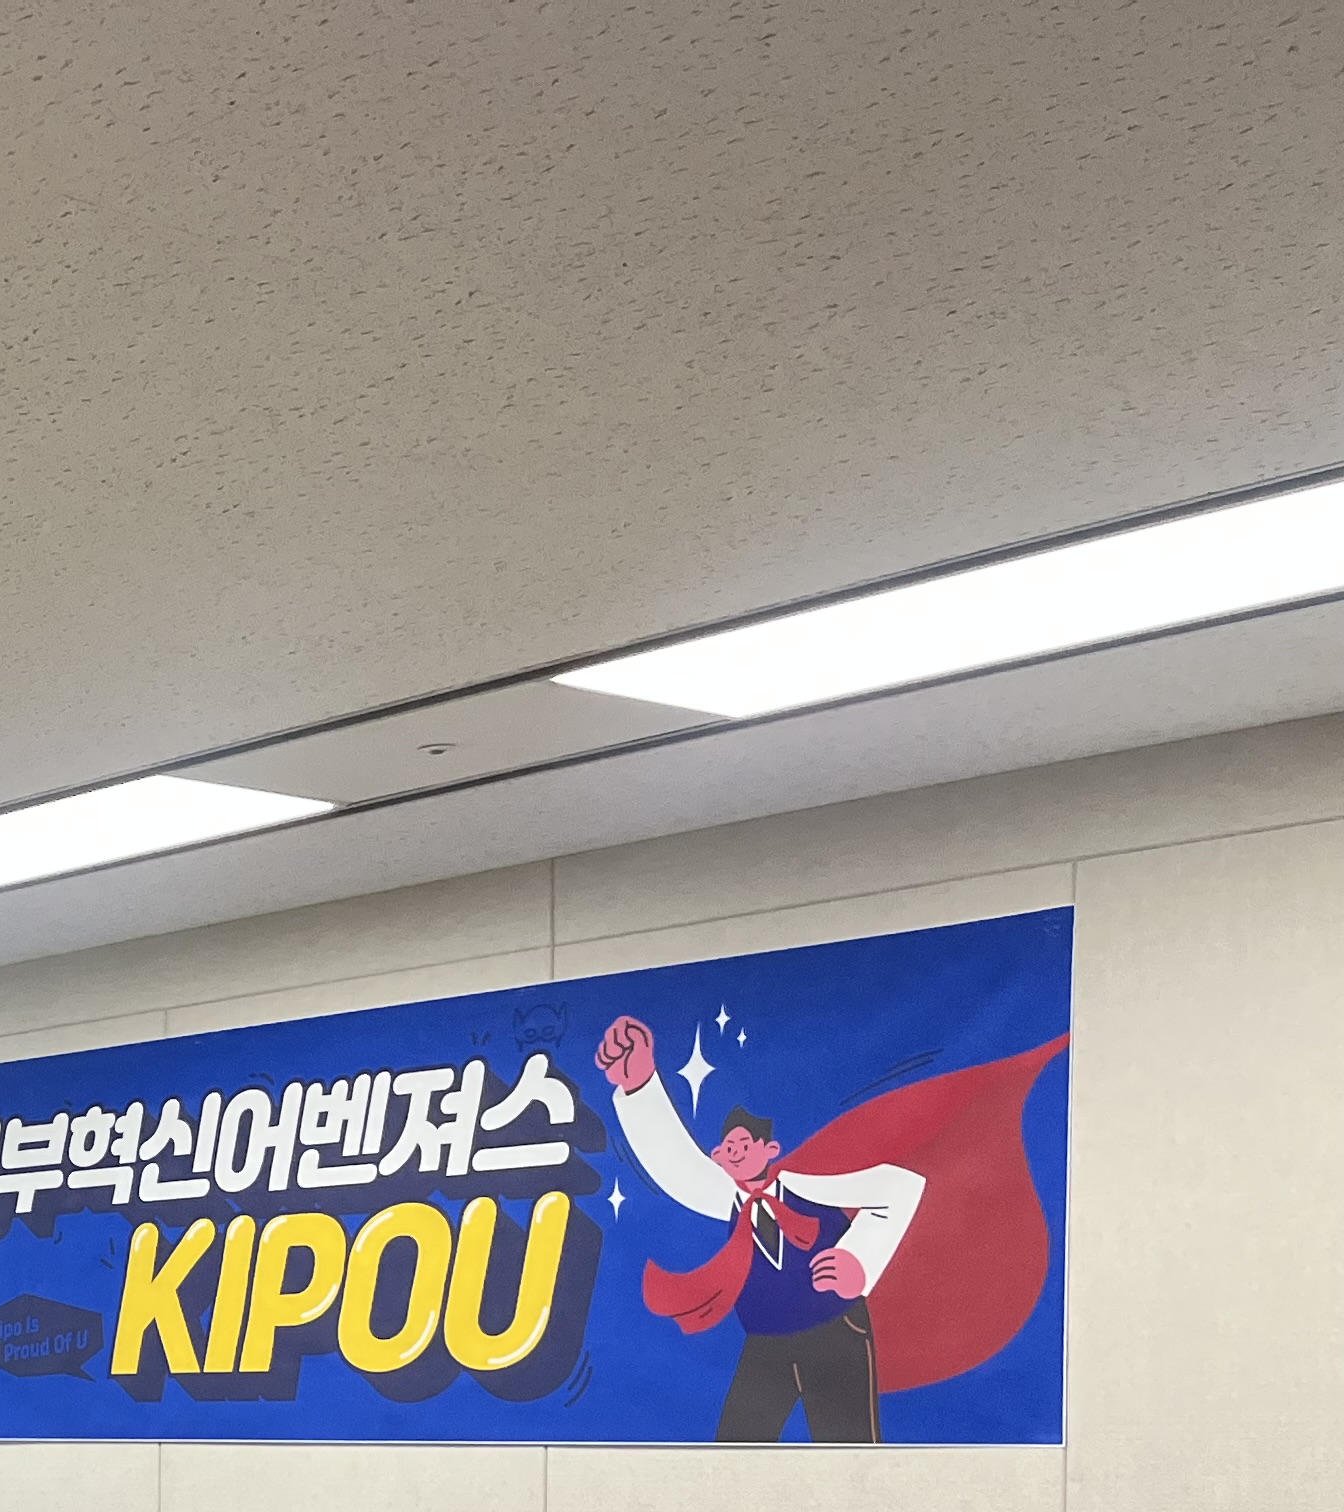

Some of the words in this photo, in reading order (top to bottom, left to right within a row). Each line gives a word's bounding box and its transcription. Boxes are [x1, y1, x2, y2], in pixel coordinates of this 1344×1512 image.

[112, 1193, 570, 1375] KIPOU
[4, 1336, 50, 1362] Proud
[54, 1332, 73, 1354] Of
[76, 1328, 89, 1350] U
